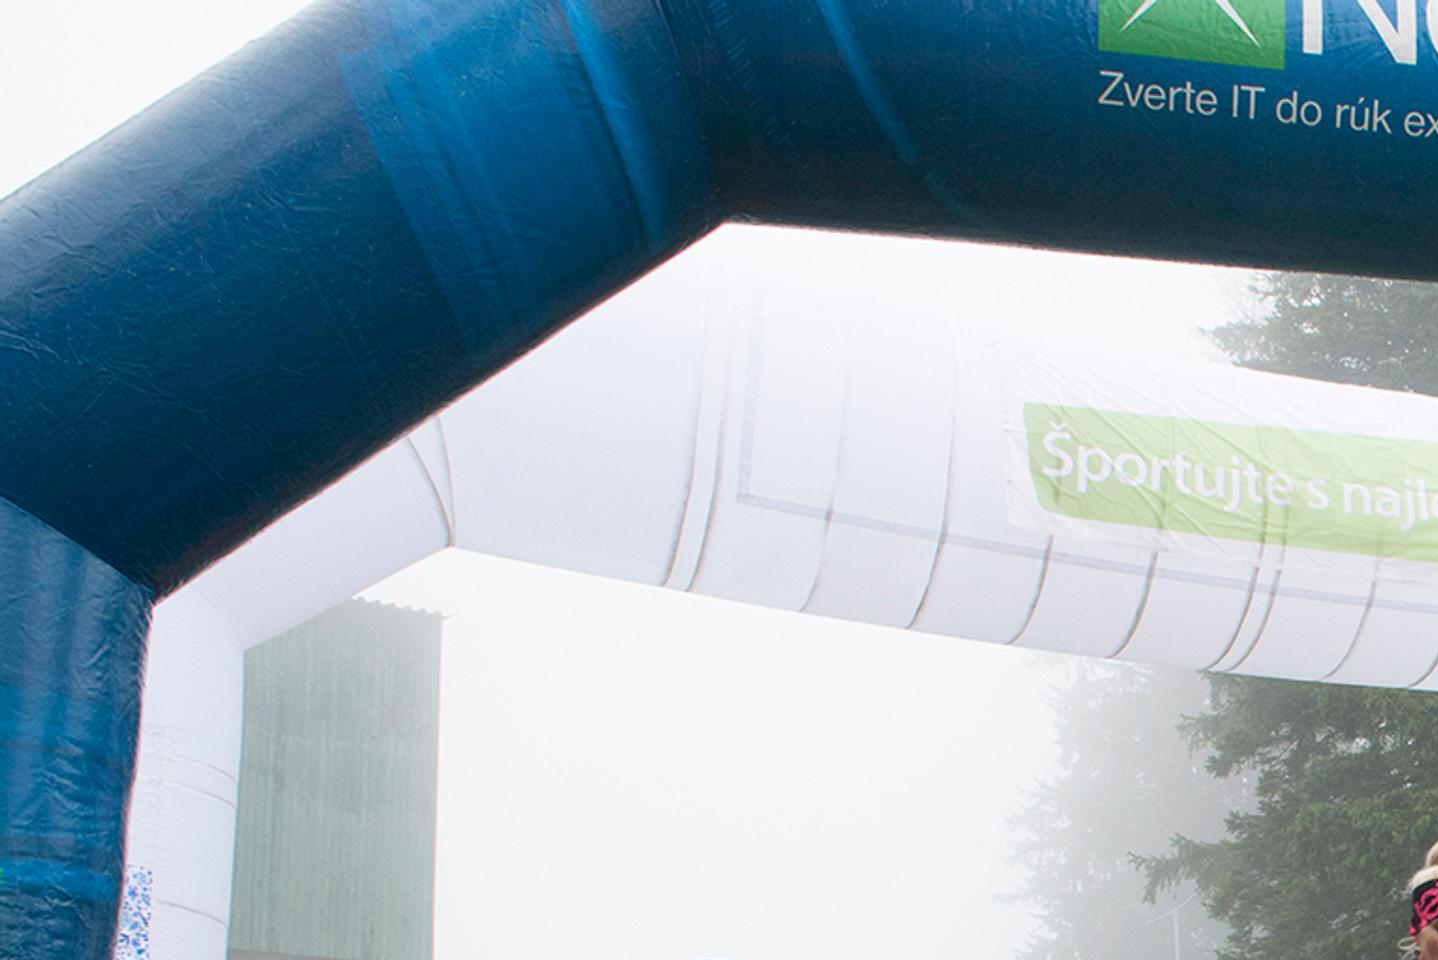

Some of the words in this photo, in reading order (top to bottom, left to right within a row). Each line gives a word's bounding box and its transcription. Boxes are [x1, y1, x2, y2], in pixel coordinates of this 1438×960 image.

[1098, 70, 1217, 115] Zverte
[1231, 84, 1265, 119] IT
[1275, 91, 1322, 126] do
[1335, 97, 1391, 134] rúk
[1042, 421, 1294, 511] Športujte
[1308, 476, 1329, 509] s
